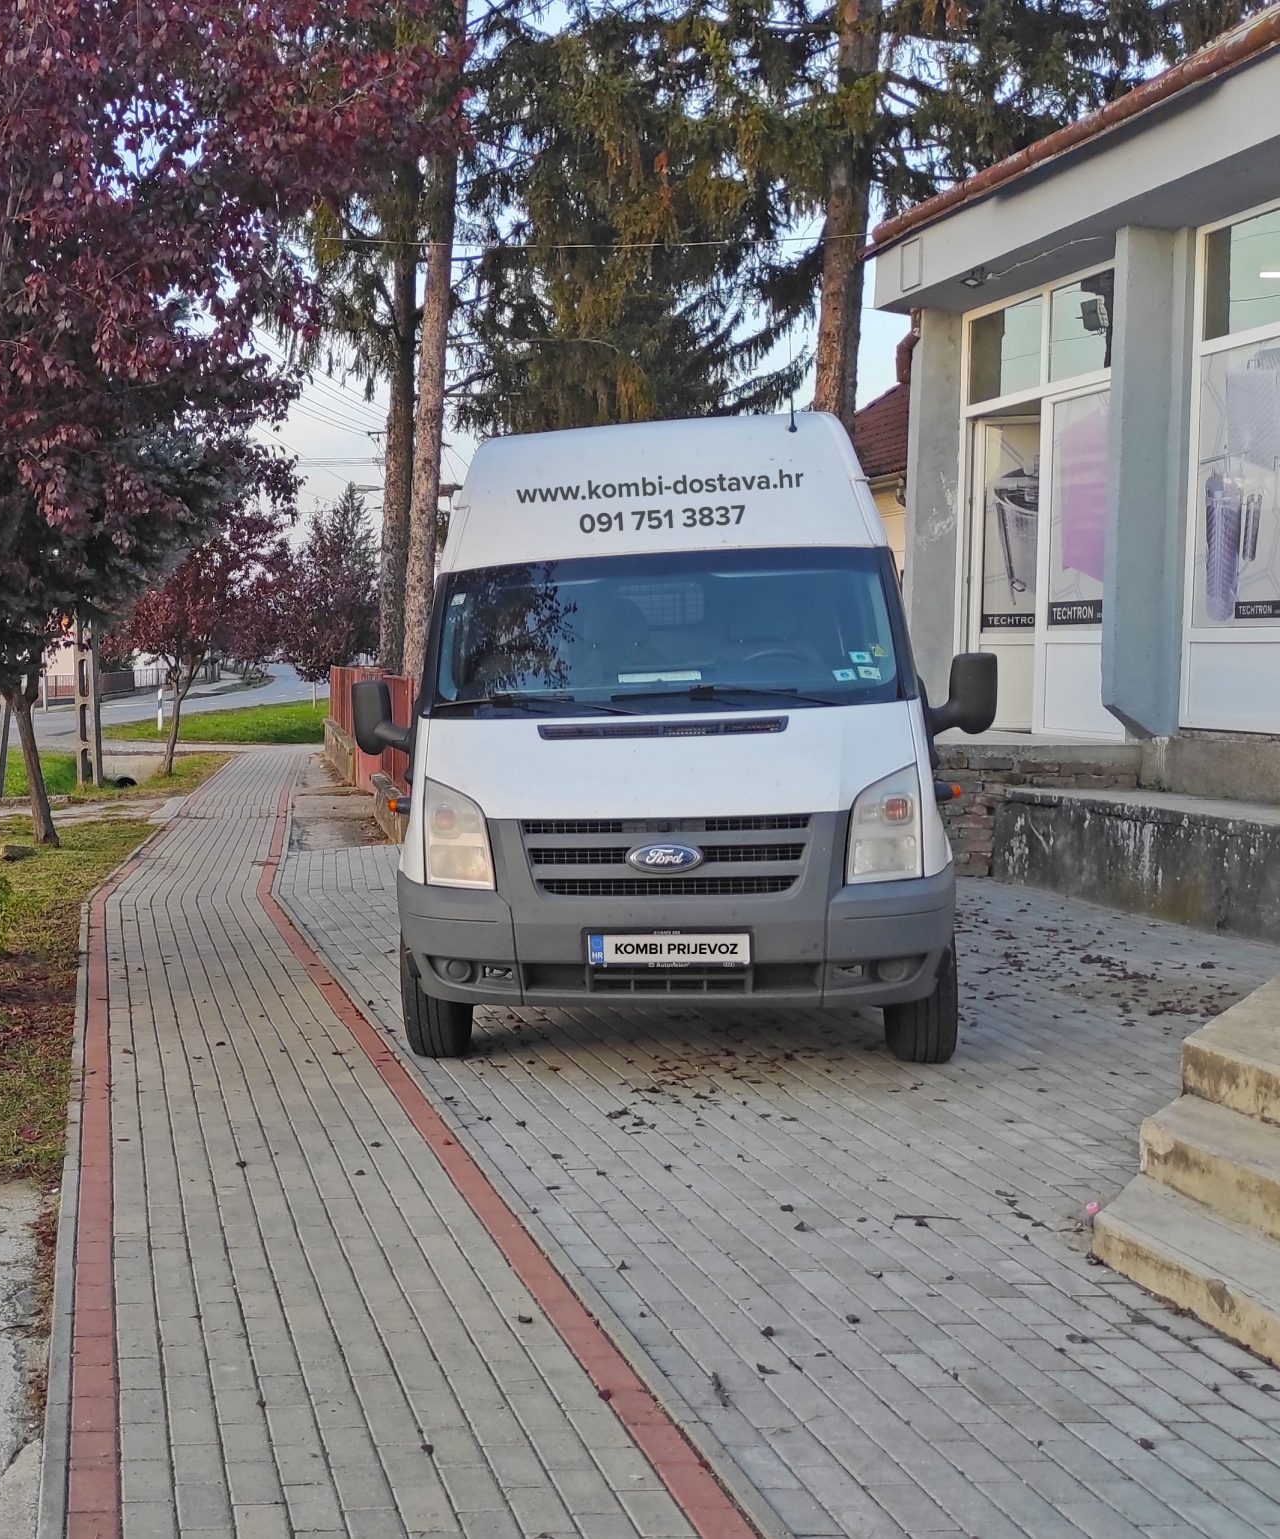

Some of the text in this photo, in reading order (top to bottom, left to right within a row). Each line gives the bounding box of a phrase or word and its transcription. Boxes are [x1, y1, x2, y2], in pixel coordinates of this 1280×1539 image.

[516, 469, 804, 504] www.kombi-dostava.hr
[578, 504, 746, 534] 091 751 3837
[1052, 606, 1094, 620] TECHTRON
[1238, 604, 1273, 615] TECHTRON
[645, 848, 684, 865] Ford
[591, 951, 604, 960] HR
[614, 942, 739, 955] KOMBI PRIJEVOZ
